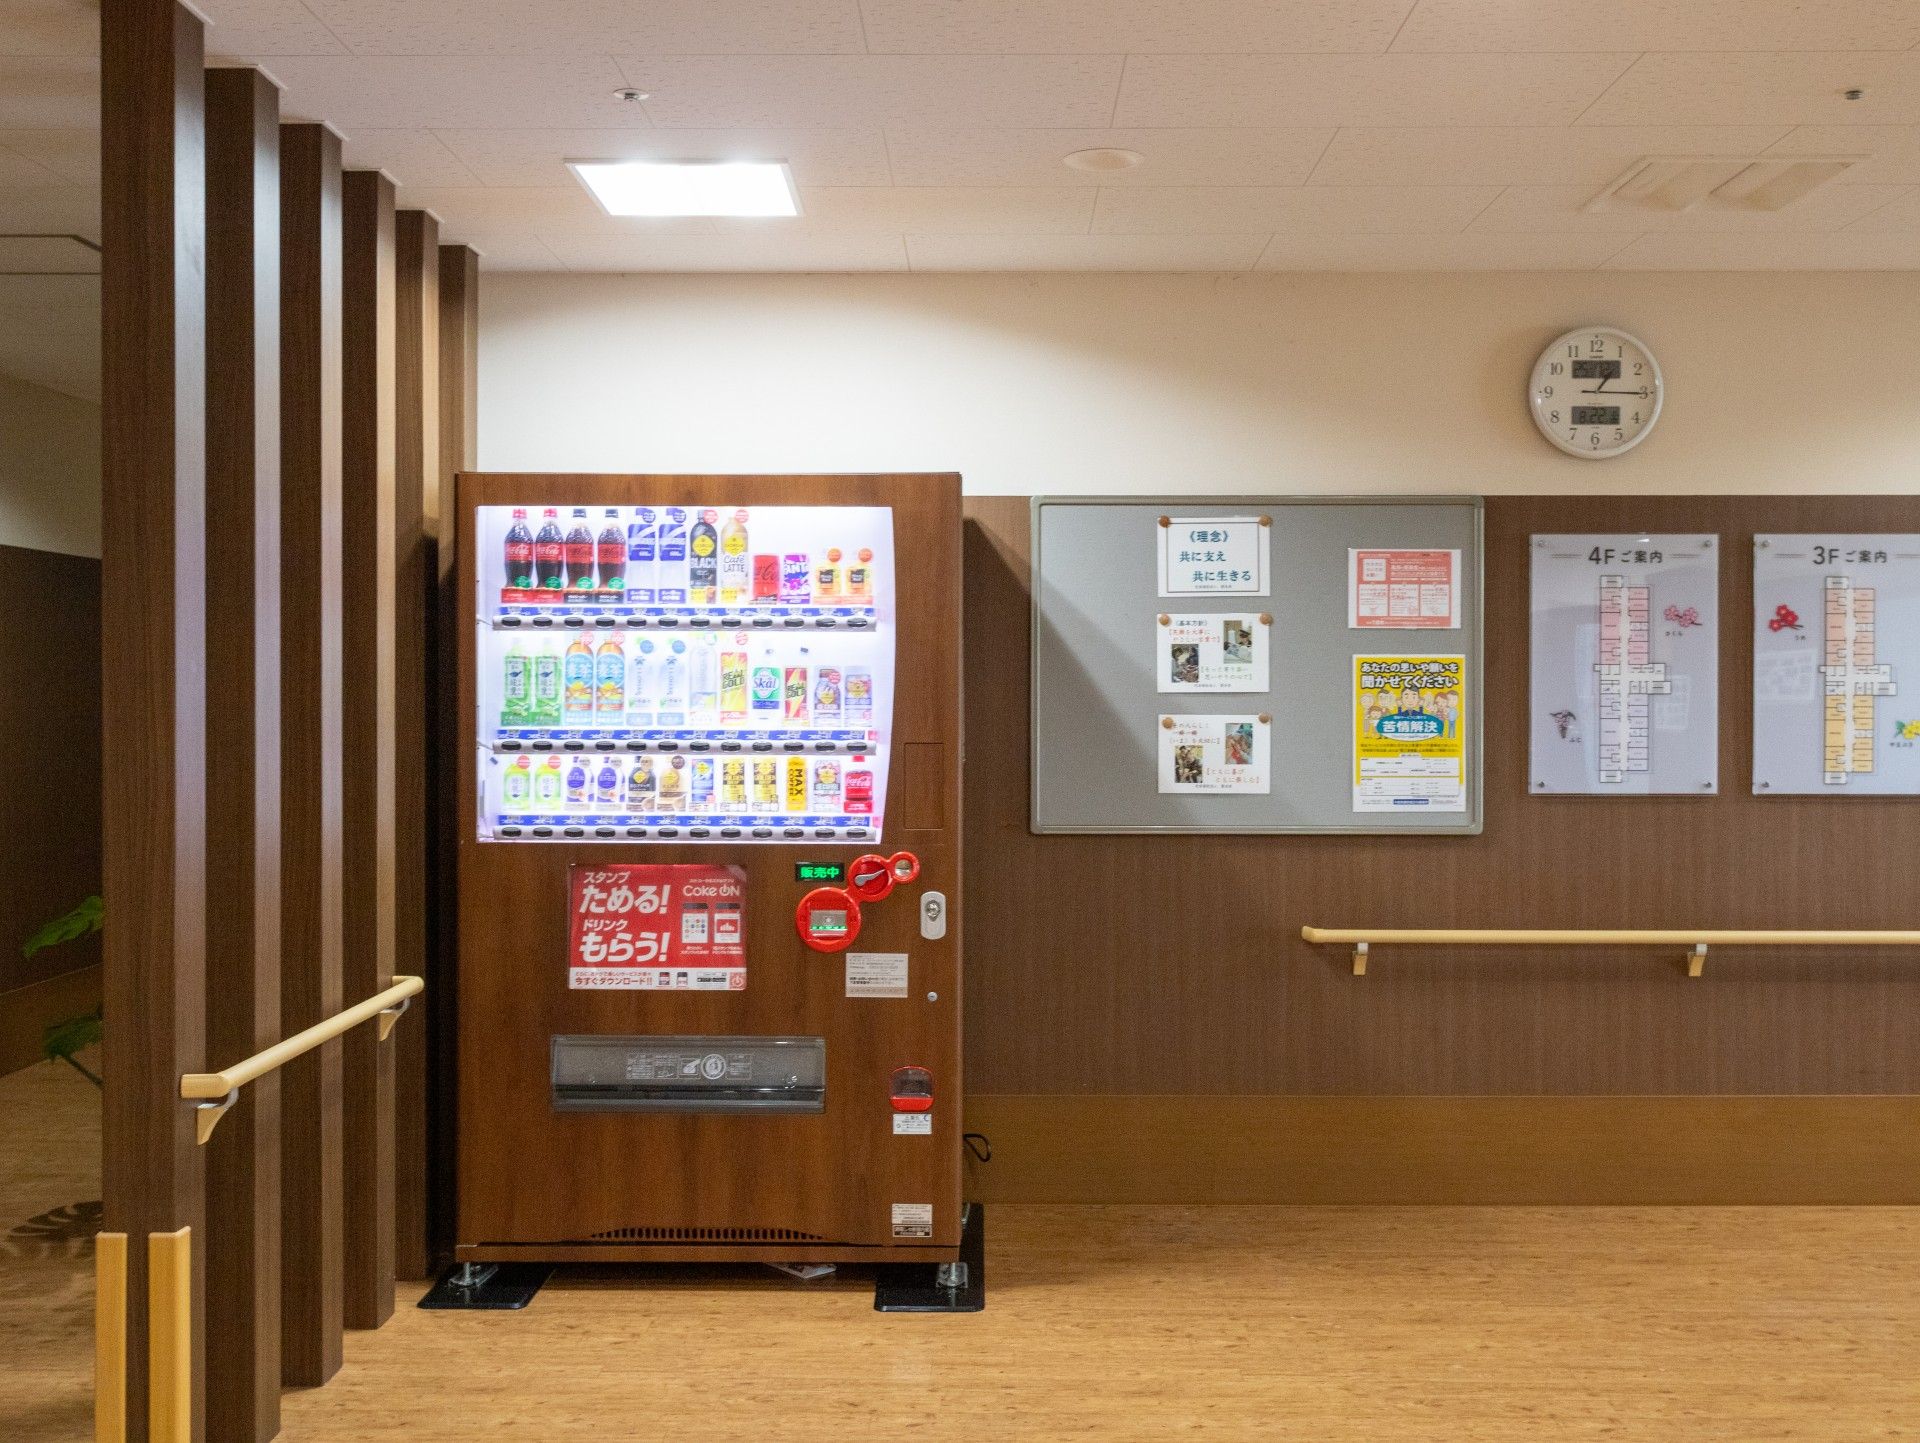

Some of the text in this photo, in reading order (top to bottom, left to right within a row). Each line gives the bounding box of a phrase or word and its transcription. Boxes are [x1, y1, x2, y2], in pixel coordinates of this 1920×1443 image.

[1568, 345, 1579, 358] 11
[1590, 339, 1604, 353] 12
[1550, 362, 1563, 376] 10
[1550, 410, 1560, 423] 8
[1631, 411, 1642, 424] 4
[1569, 428, 1578, 441] 7
[1590, 432, 1600, 446] 6
[1614, 428, 1623, 441] 5
[1178, 551, 1227, 562] 共に支え
[723, 564, 745, 573] LATTE
[1192, 570, 1252, 583] 共に生きる
[1361, 662, 1458, 674] あなたの思いや願いを
[1361, 675, 1459, 690] 聞かせてください
[1382, 720, 1438, 733] 苦情解決
[794, 768, 803, 796] MAX
[583, 871, 631, 884] スタンプ
[800, 866, 840, 879] 販売中
[682, 885, 718, 897] Coke
[582, 918, 629, 932] ドリンク
